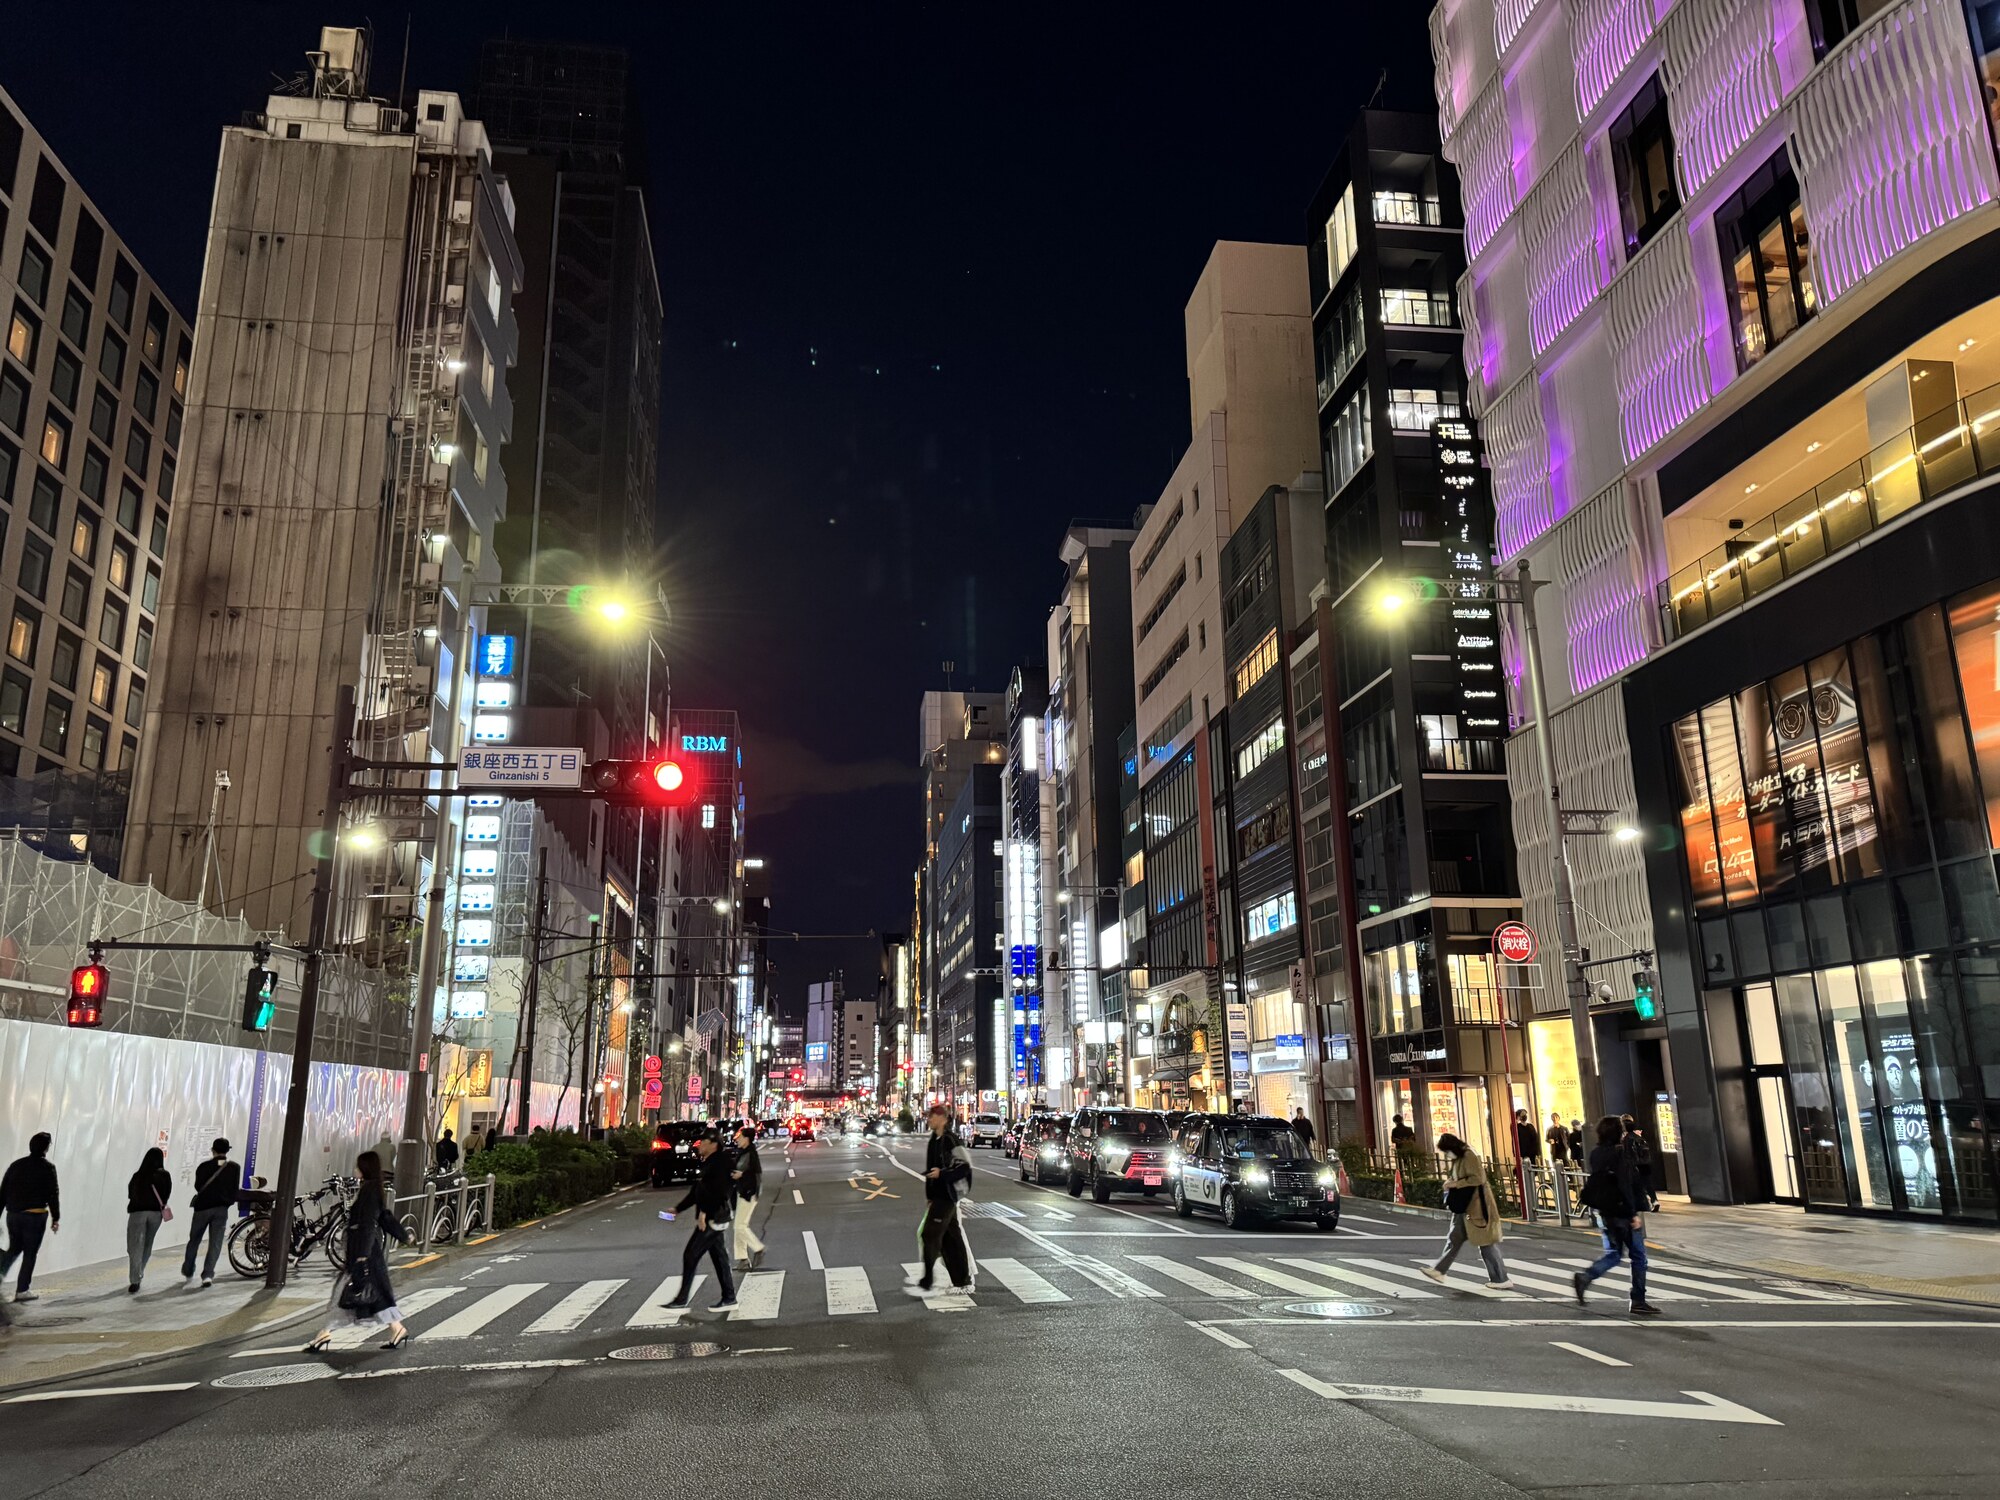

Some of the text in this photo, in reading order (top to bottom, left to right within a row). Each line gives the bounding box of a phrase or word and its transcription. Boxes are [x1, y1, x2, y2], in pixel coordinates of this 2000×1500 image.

[682, 735, 727, 751] RBM
[463, 752, 577, 770] 銀座西五丁目
[489, 771, 550, 780] Ginzanishi 5
[1502, 937, 1528, 950] 消火栓
[1390, 1052, 1407, 1063] GINZA
